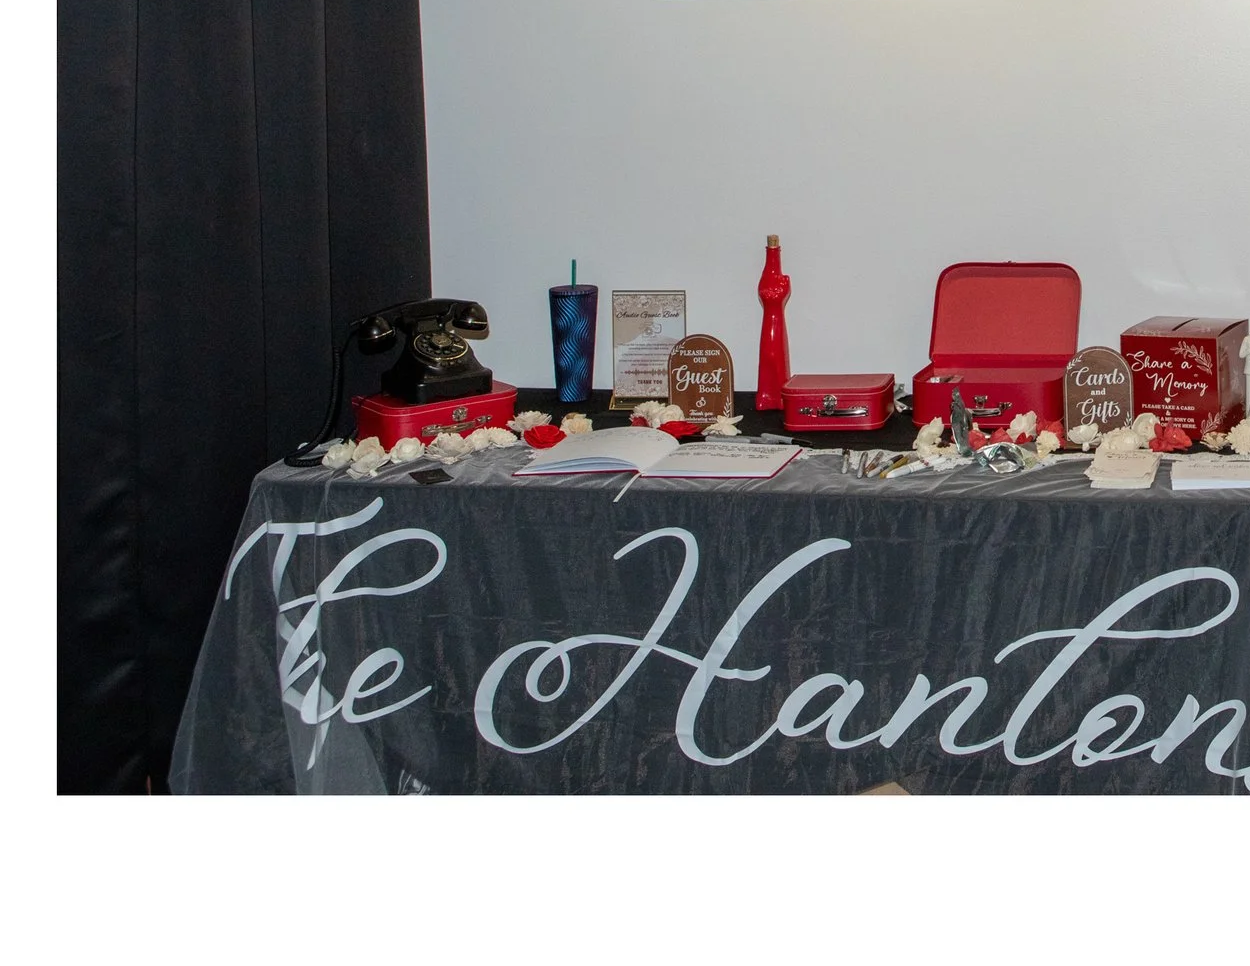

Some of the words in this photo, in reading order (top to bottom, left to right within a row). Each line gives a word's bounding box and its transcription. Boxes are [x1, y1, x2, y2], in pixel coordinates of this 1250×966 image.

[616, 311, 639, 319] Audio
[640, 310, 662, 319] Guest
[662, 310, 680, 318] Book
[1126, 350, 1174, 372] Share
[1181, 359, 1193, 370] a
[672, 364, 727, 392] Guest
[1070, 366, 1125, 386] Cards
[1145, 372, 1209, 397] Memory
[699, 384, 722, 393] Book
[1090, 387, 1106, 396] and
[1076, 398, 1121, 425] Gifts
[224, 496, 448, 771] The
